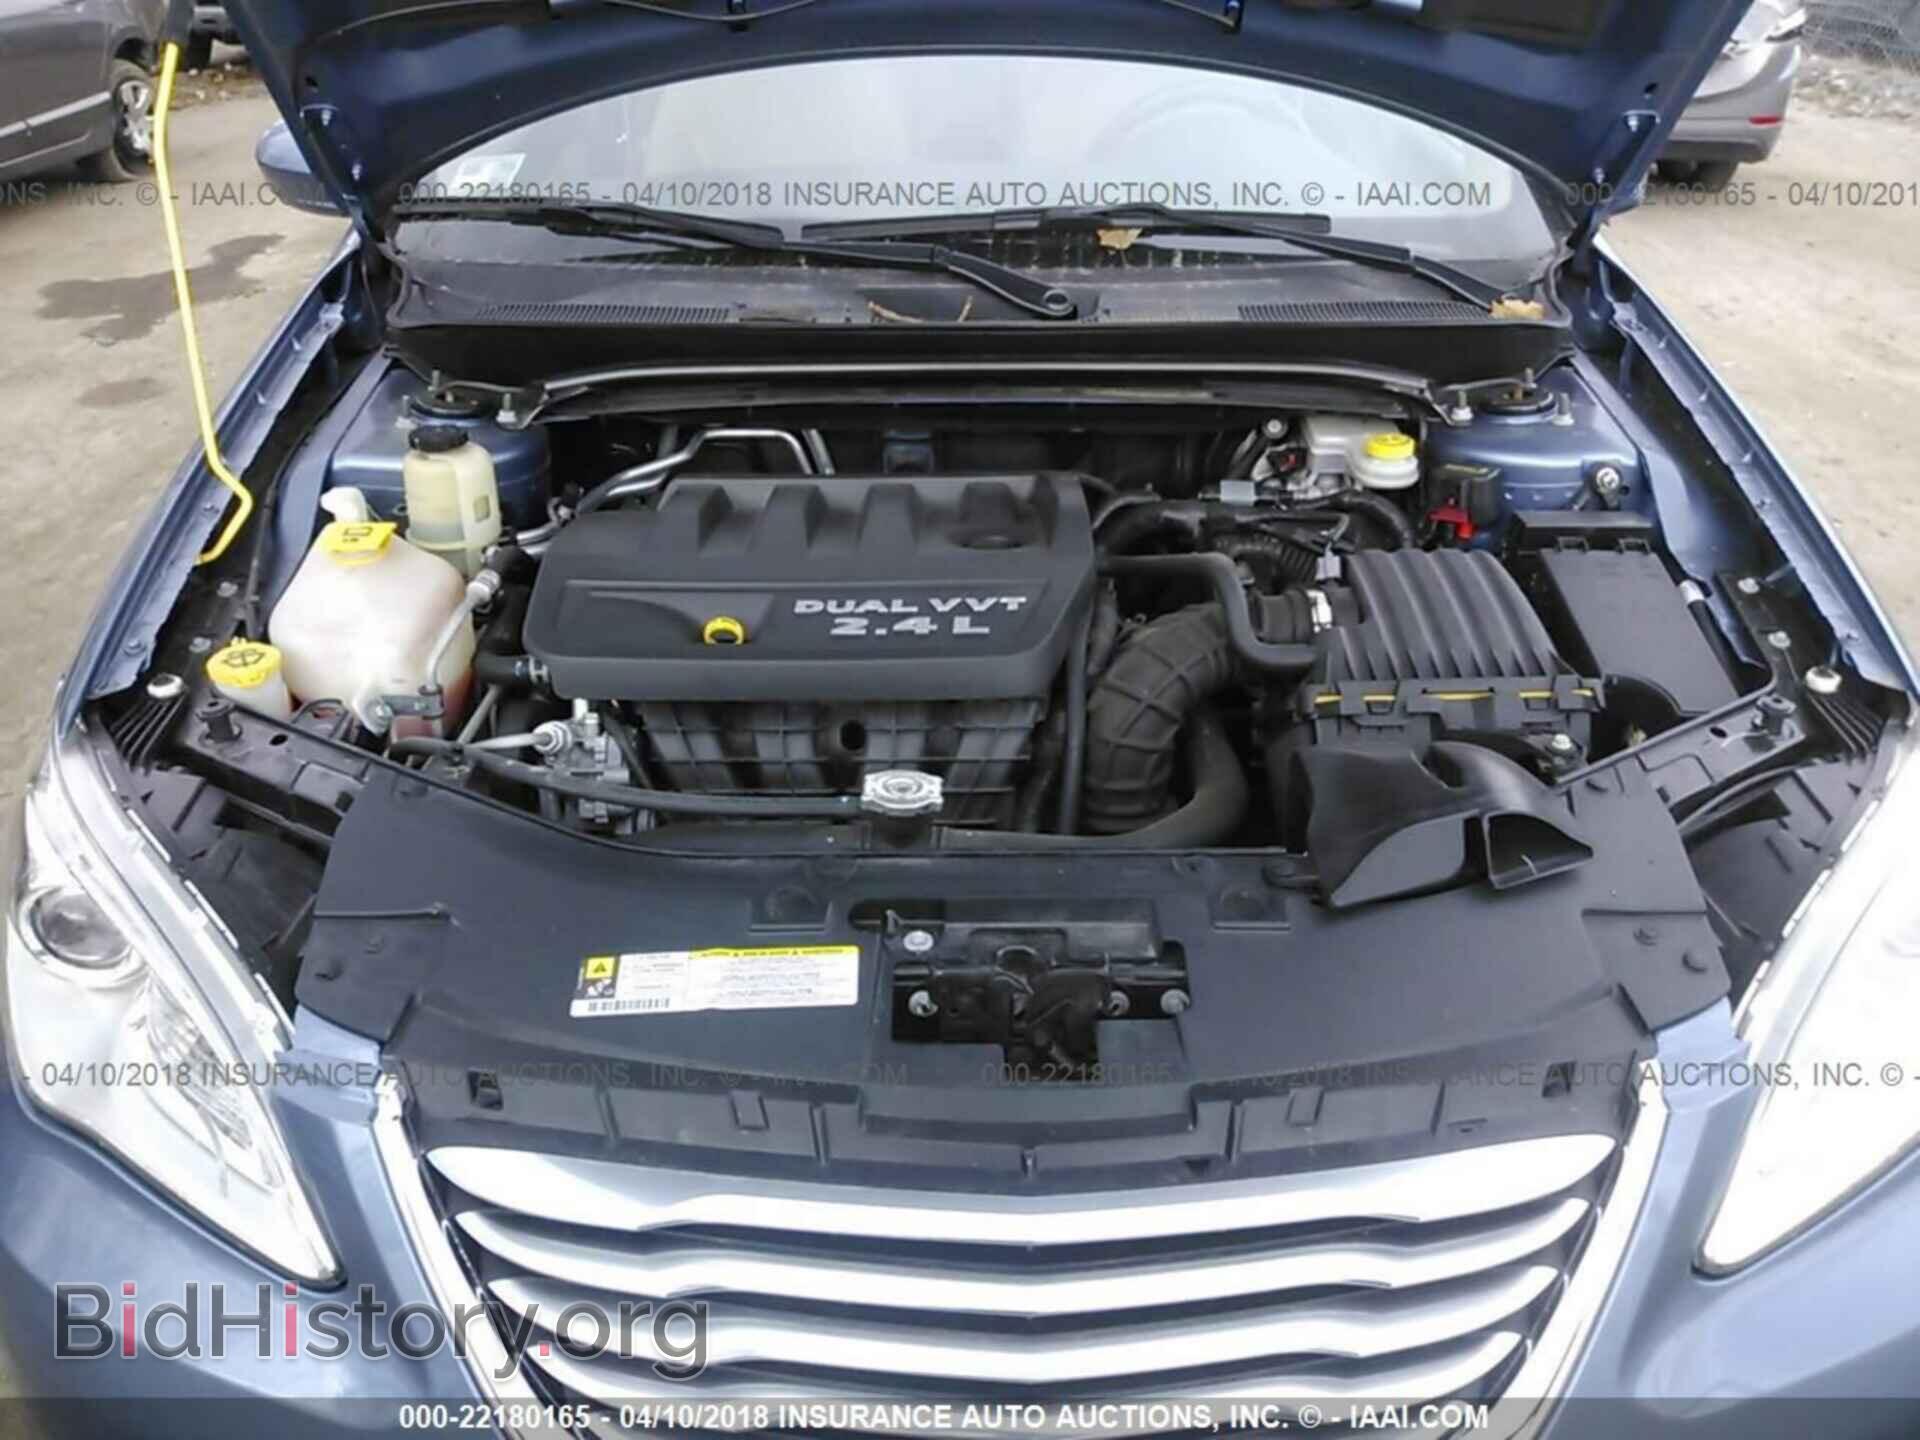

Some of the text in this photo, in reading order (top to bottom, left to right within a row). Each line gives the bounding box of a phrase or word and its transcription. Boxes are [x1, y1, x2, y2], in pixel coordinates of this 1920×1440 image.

[793, 596, 1028, 614] DUAL VVT
[829, 615, 991, 636] 2.4 L
